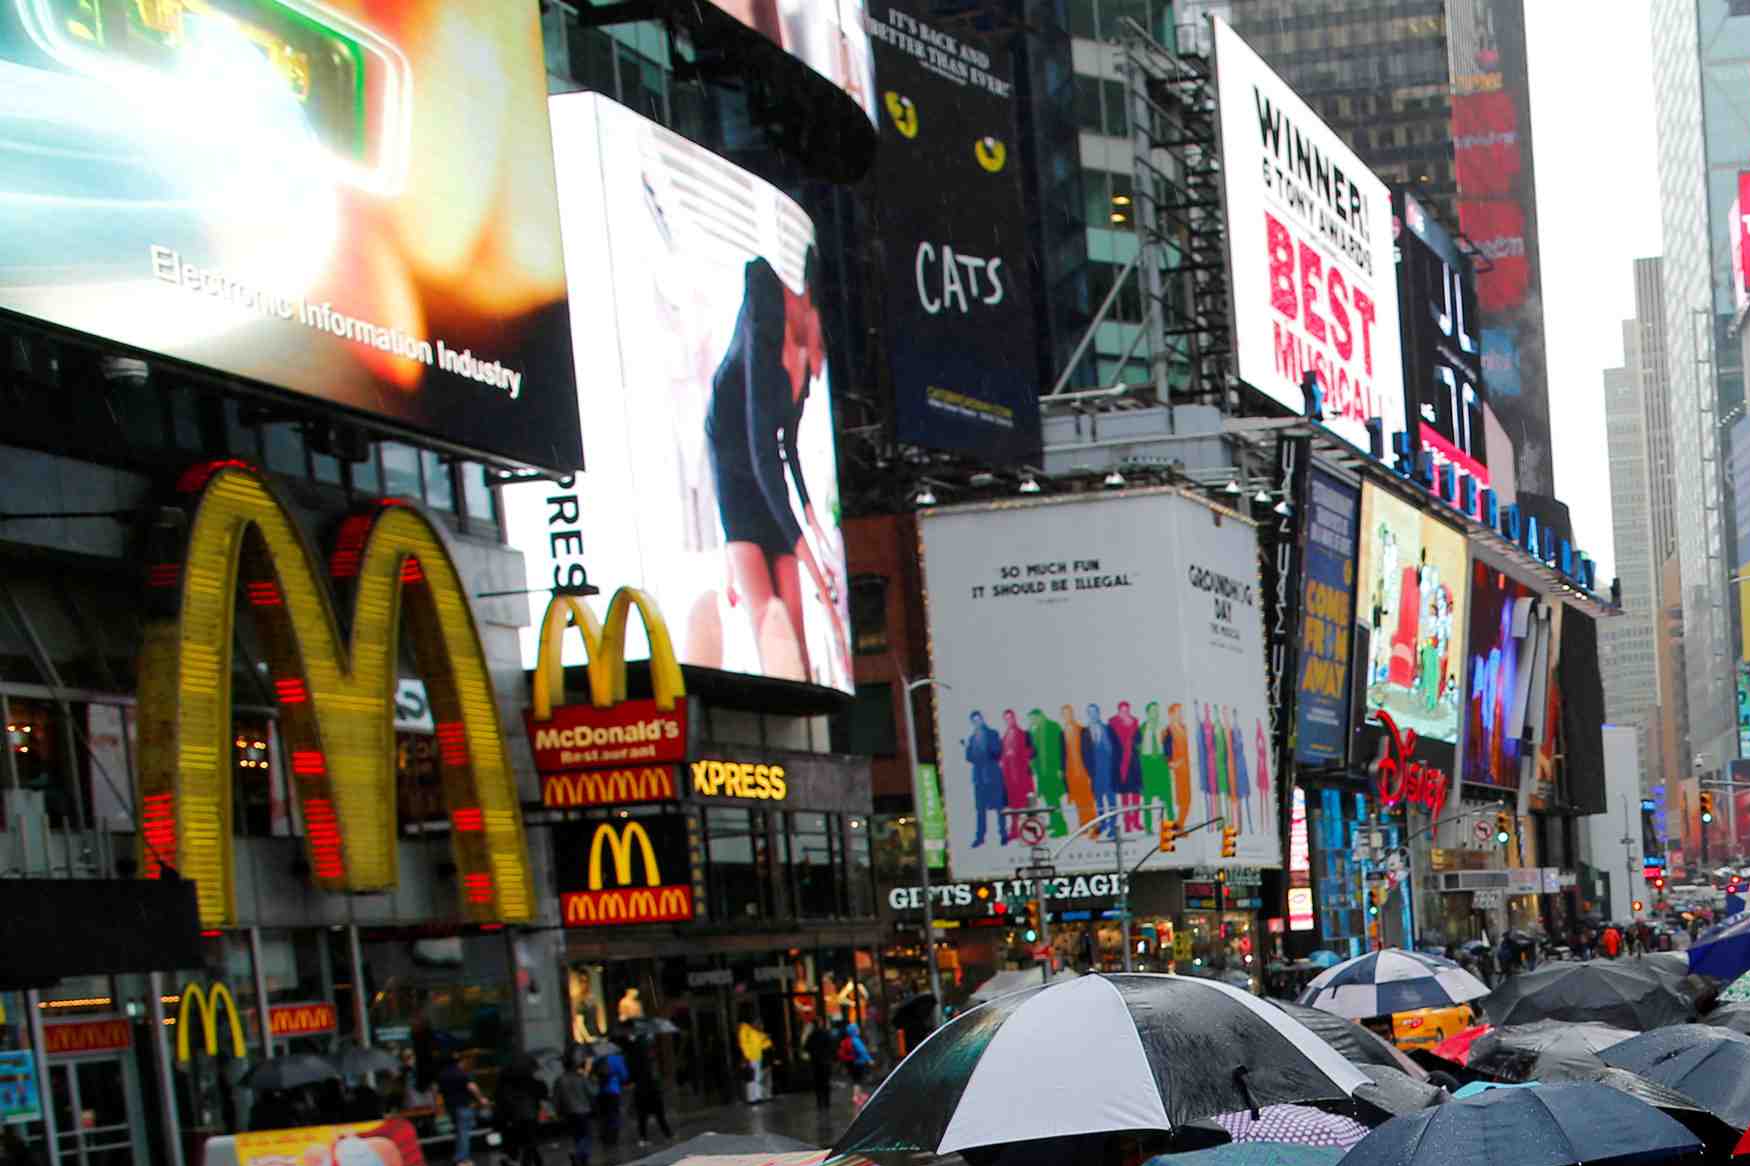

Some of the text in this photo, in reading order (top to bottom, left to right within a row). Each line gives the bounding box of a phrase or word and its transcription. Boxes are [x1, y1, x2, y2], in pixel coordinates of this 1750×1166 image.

[919, 23, 957, 54] BACK
[959, 45, 990, 69] AND
[927, 47, 968, 80] THAN
[1253, 84, 1373, 243] WINNER!
[1275, 168, 1315, 221] TONY
[1318, 207, 1373, 278] AWARDS
[915, 240, 1004, 314] CATS
[1264, 209, 1376, 378] BEST
[150, 244, 524, 400] Electronic Information Industry
[972, 586, 985, 600] IT
[992, 581, 1046, 598] SHOULD
[1050, 578, 1068, 592] BE
[1000, 559, 1101, 579] SO MUCH FUN
[1214, 597, 1233, 625] DAY
[535, 717, 680, 751] McDonald's
[560, 744, 656, 765] Restaurant
[690, 760, 787, 800] XPRESS
